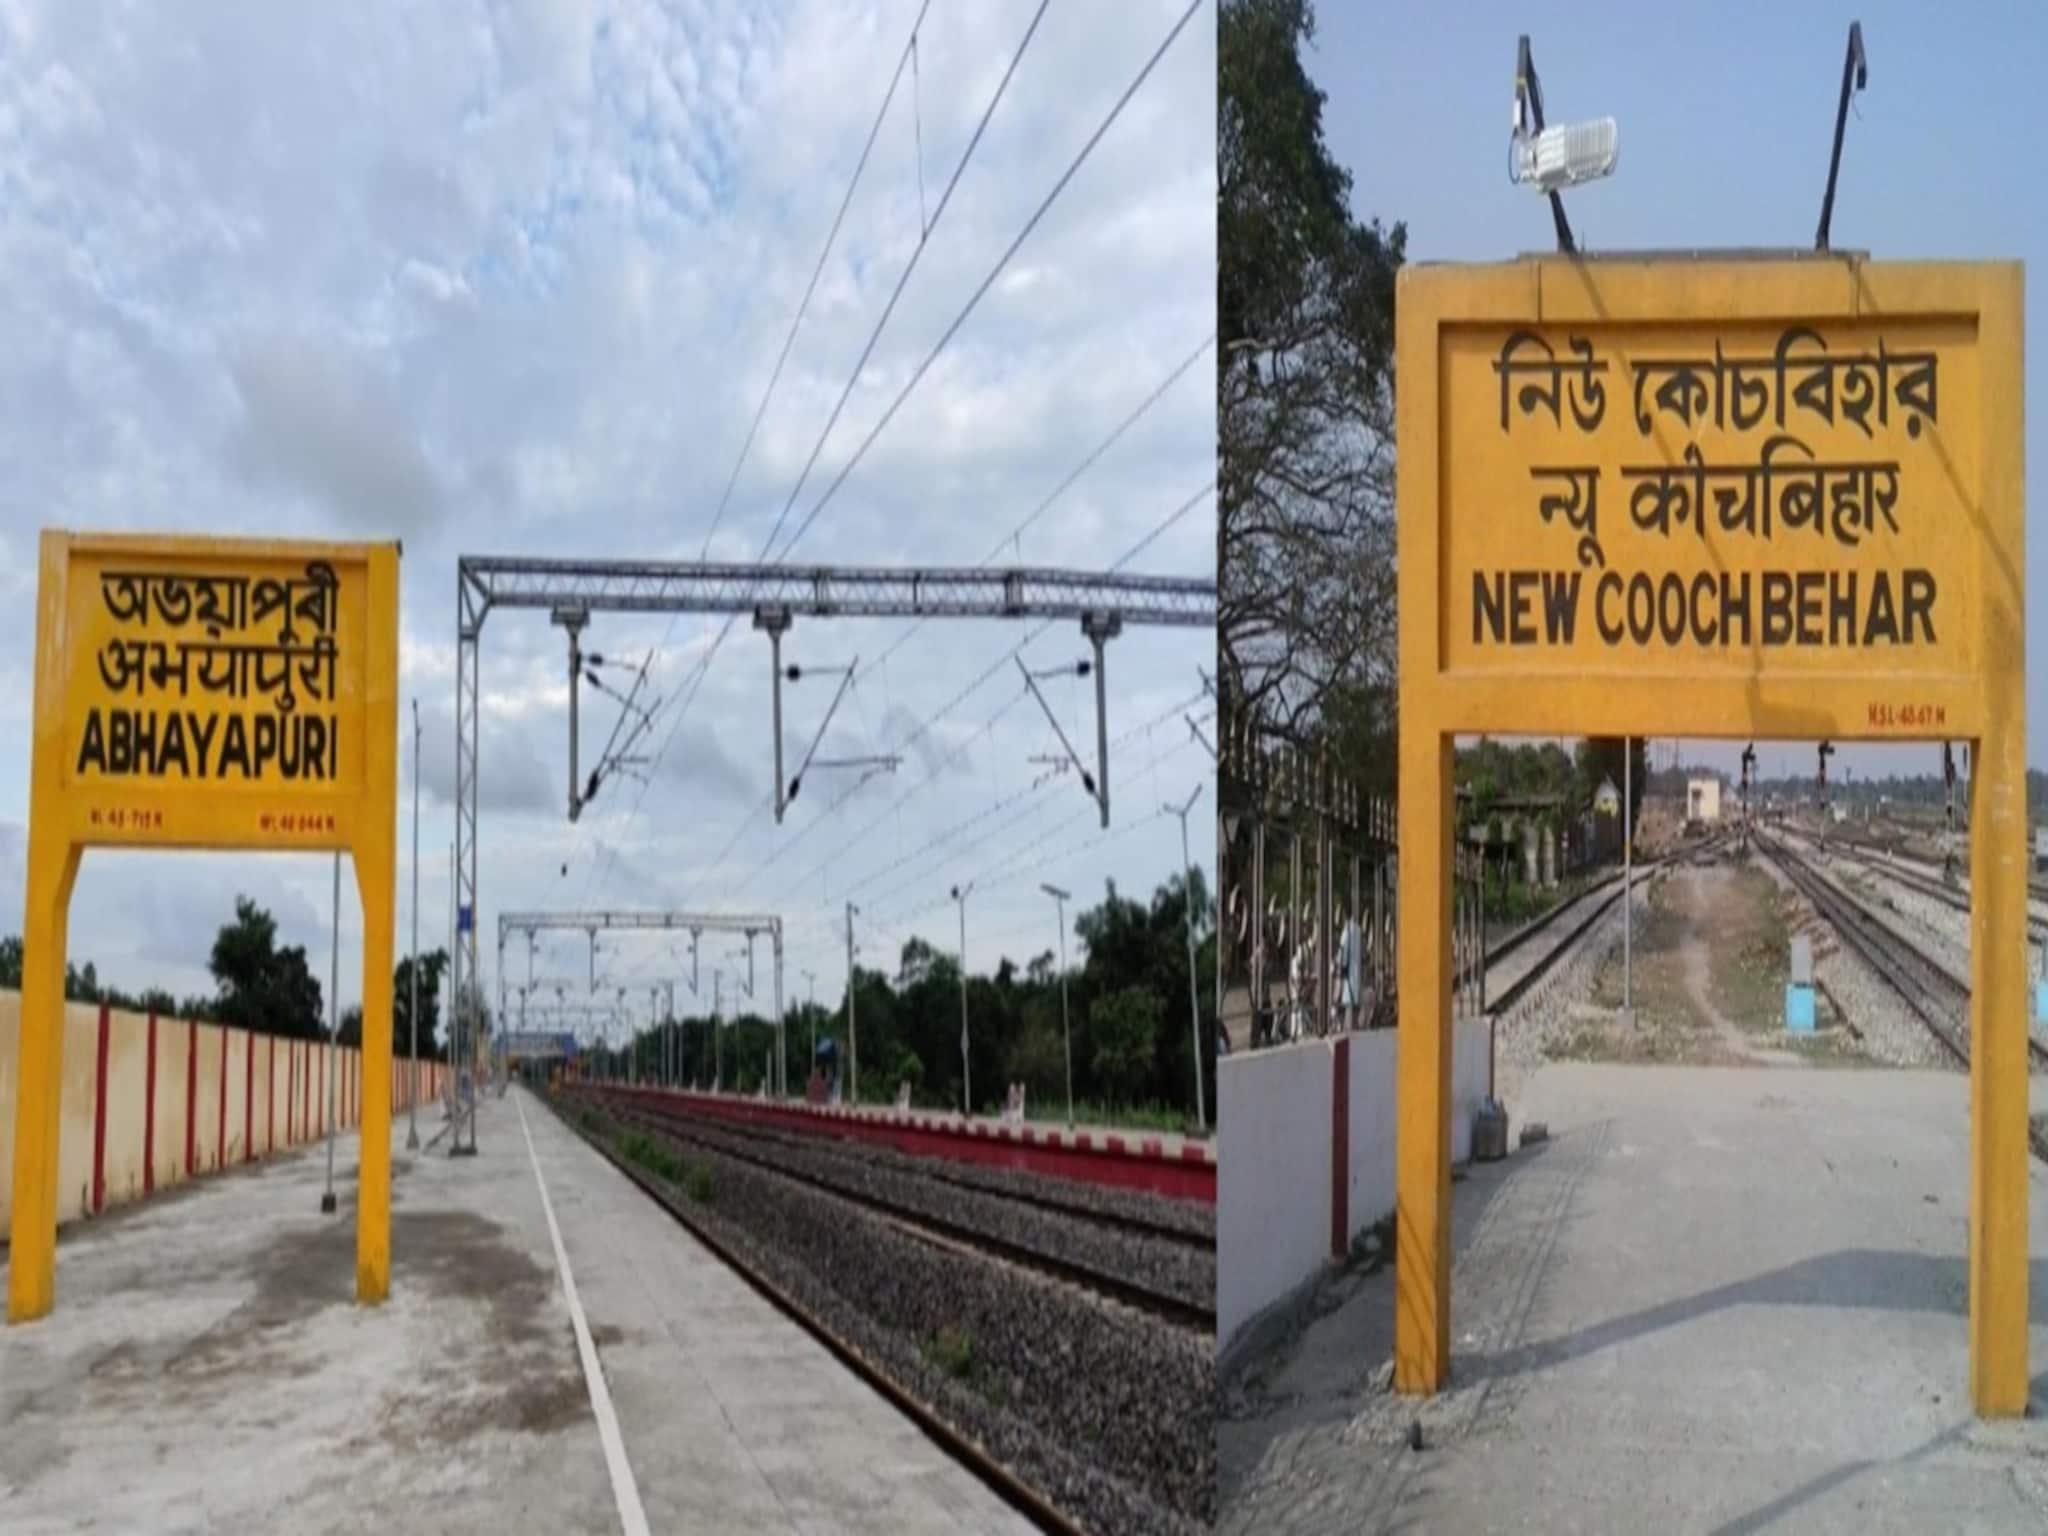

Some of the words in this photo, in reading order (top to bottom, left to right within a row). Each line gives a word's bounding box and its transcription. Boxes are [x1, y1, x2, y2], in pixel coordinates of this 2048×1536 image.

[1492, 330, 1608, 434] নিউ
[1630, 326, 1938, 438] কোচবিহার
[1530, 467, 1605, 568] न्यू
[1472, 571, 1582, 645] NEW
[97, 636, 339, 713] अभयापुरी
[76, 707, 338, 780] ABHAYAPURI
